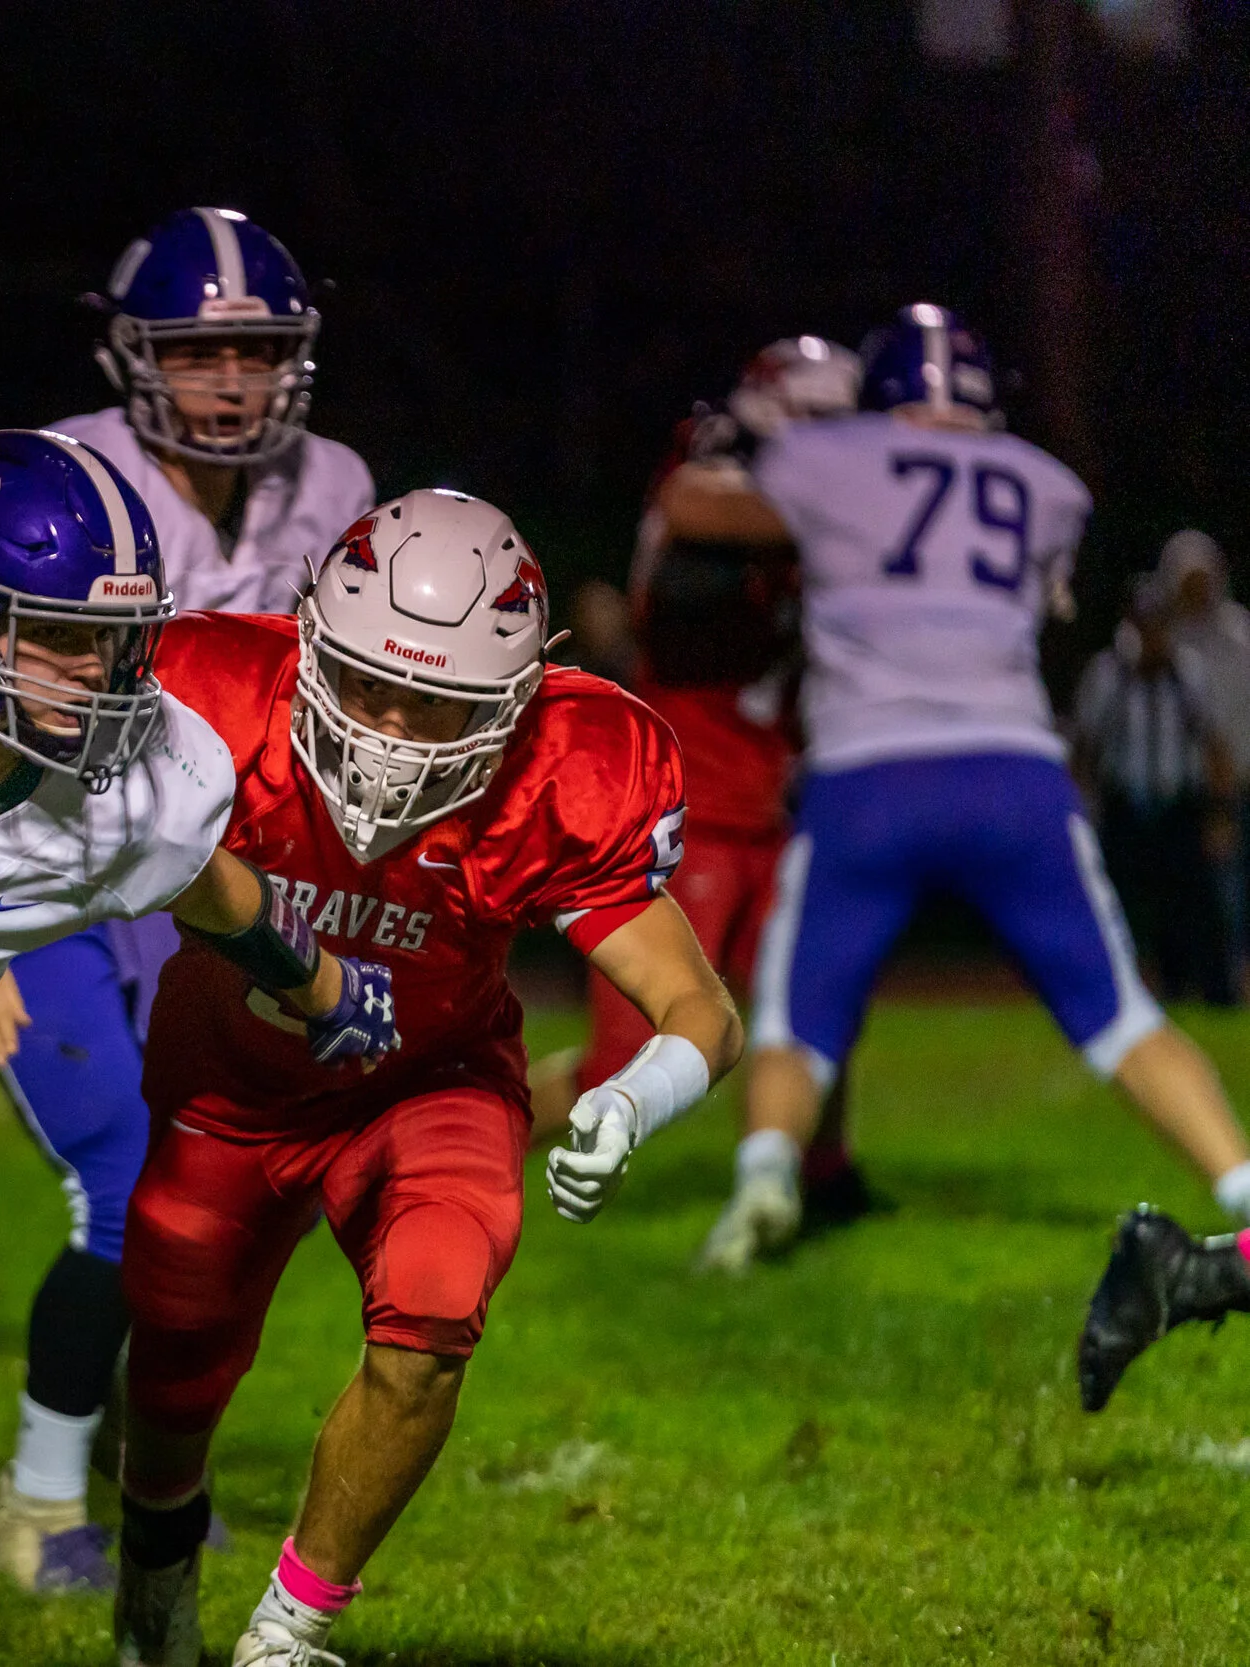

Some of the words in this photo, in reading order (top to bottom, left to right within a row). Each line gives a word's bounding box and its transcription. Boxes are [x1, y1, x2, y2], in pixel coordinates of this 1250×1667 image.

[882, 449, 1031, 593] 79
[103, 580, 152, 596] Riddell
[384, 638, 447, 668] Riddell
